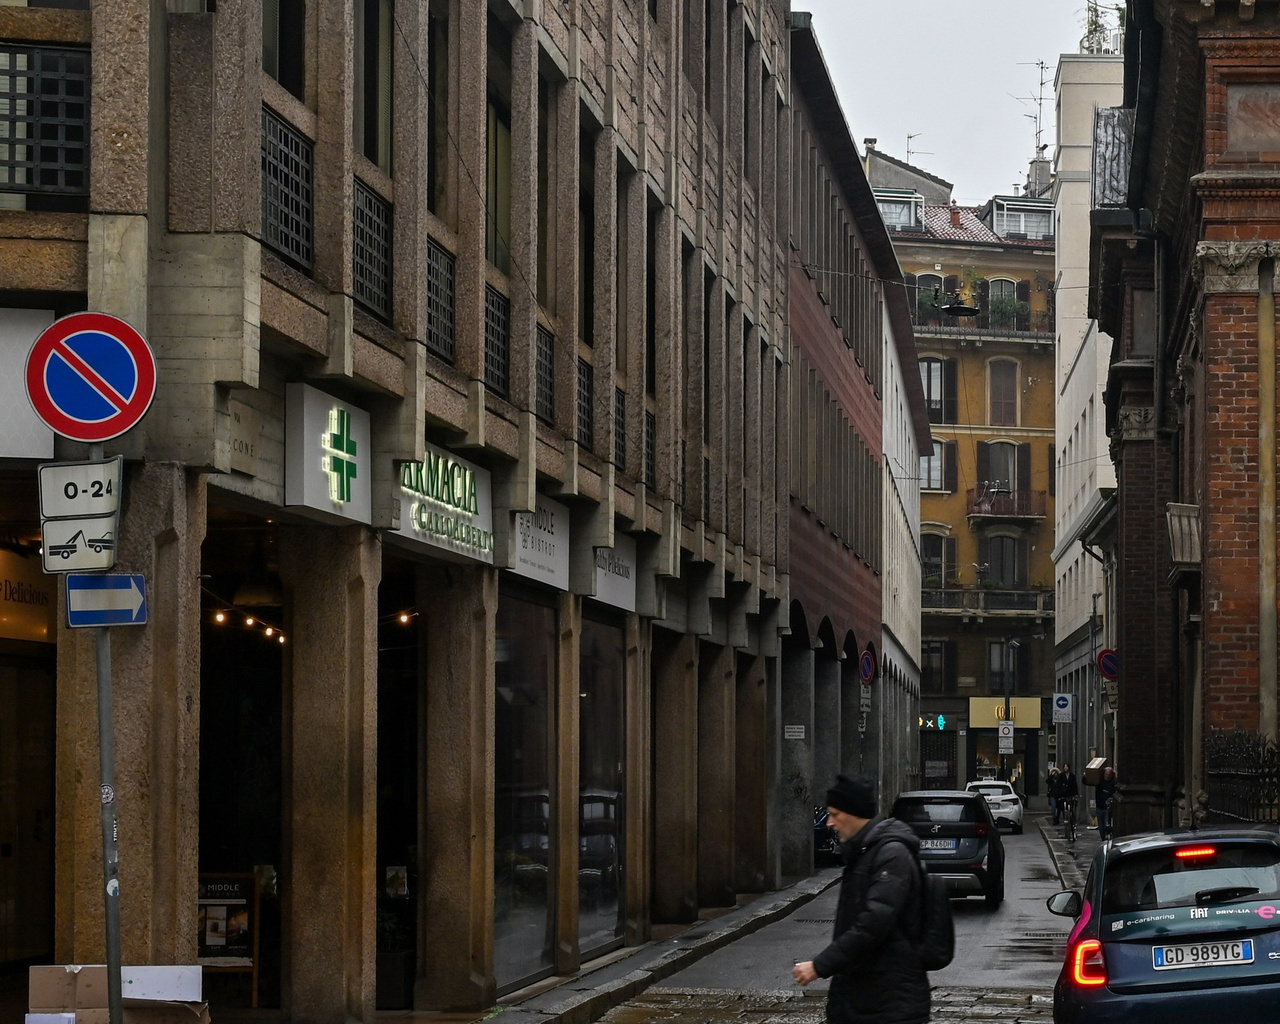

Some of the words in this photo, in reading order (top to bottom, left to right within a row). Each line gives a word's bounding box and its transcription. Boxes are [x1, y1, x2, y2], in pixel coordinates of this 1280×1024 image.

[64, 479, 113, 499] 0-24
[4, 579, 49, 607] Delicious
[1127, 913, 1175, 926] e-carsharing
[1190, 907, 1209, 919] FIAT
[1165, 947, 1184, 964] GD
[1190, 943, 1241, 962] 989YG
